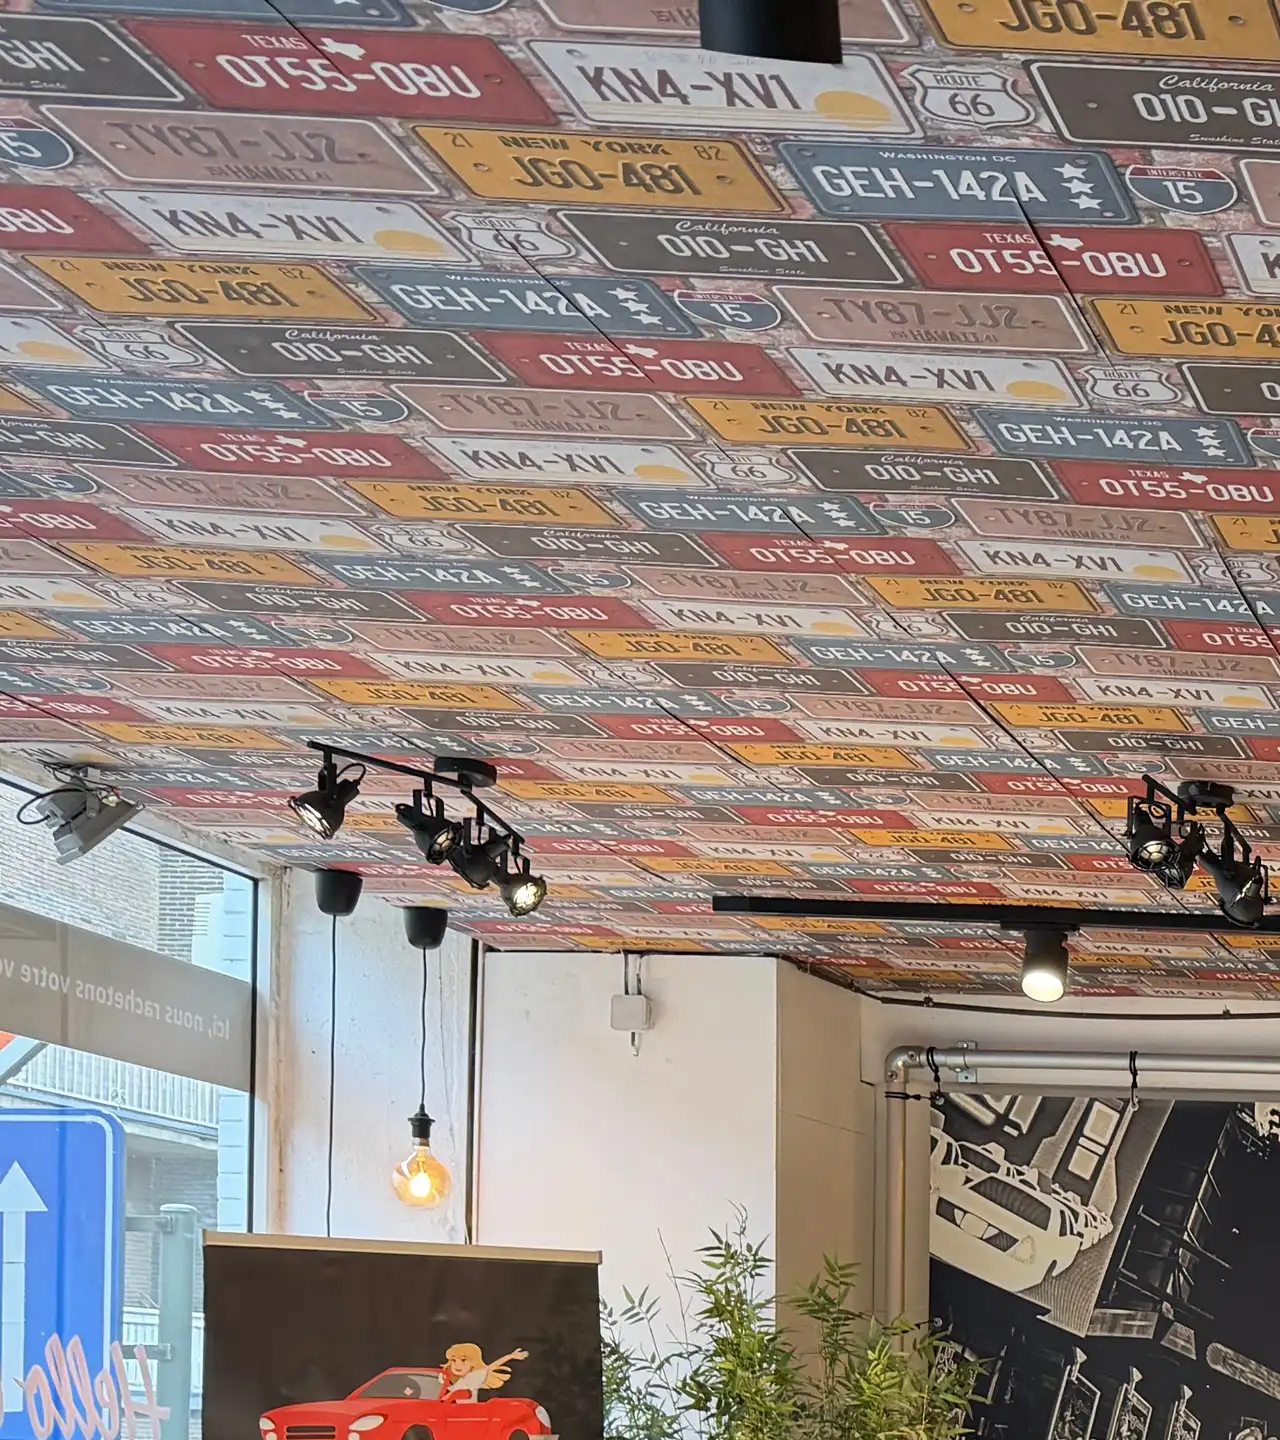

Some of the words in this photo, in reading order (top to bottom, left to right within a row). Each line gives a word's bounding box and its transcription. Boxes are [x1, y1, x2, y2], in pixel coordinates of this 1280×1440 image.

[241, 33, 309, 51] TEXAS
[932, 72, 981, 89] ROUTE
[1158, 73, 1275, 94] California
[947, 91, 997, 118] 66
[442, 132, 475, 149] 21
[497, 135, 571, 151] NEW
[579, 138, 672, 156] YORK
[692, 144, 729, 162] 82
[811, 164, 1048, 202] GEH-142A
[1161, 180, 1204, 205] 15
[675, 219, 781, 236] California
[491, 231, 541, 252] 66
[389, 283, 612, 318] GEH-142A
[708, 302, 754, 323] 15
[896, 509, 932, 524] 15
